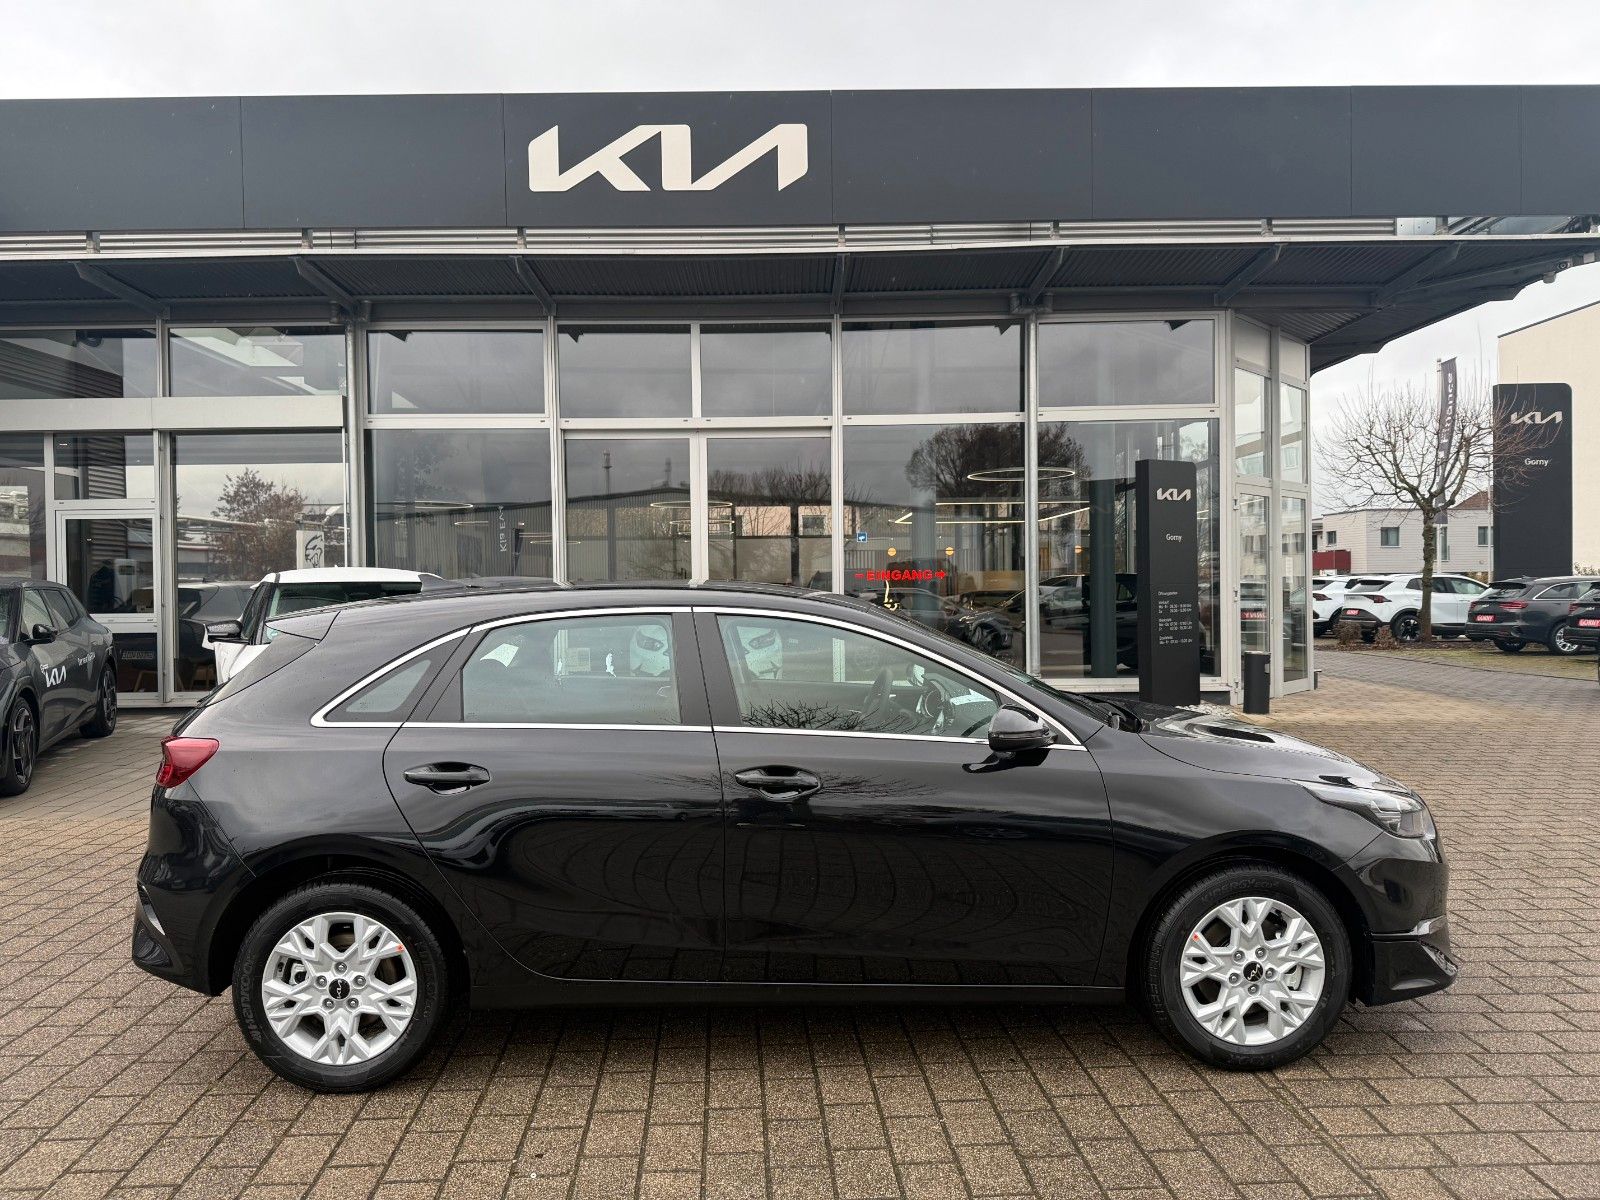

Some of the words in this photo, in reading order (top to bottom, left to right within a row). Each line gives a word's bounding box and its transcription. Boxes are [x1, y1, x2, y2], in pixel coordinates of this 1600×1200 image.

[528, 123, 808, 192] KIA
[1510, 411, 1562, 424] KIA
[1524, 457, 1549, 467] Gorny
[1156, 487, 1191, 501] KIA
[1165, 533, 1182, 542] Gorny
[866, 569, 933, 581] EINGANG
[45, 665, 67, 688] KIA
